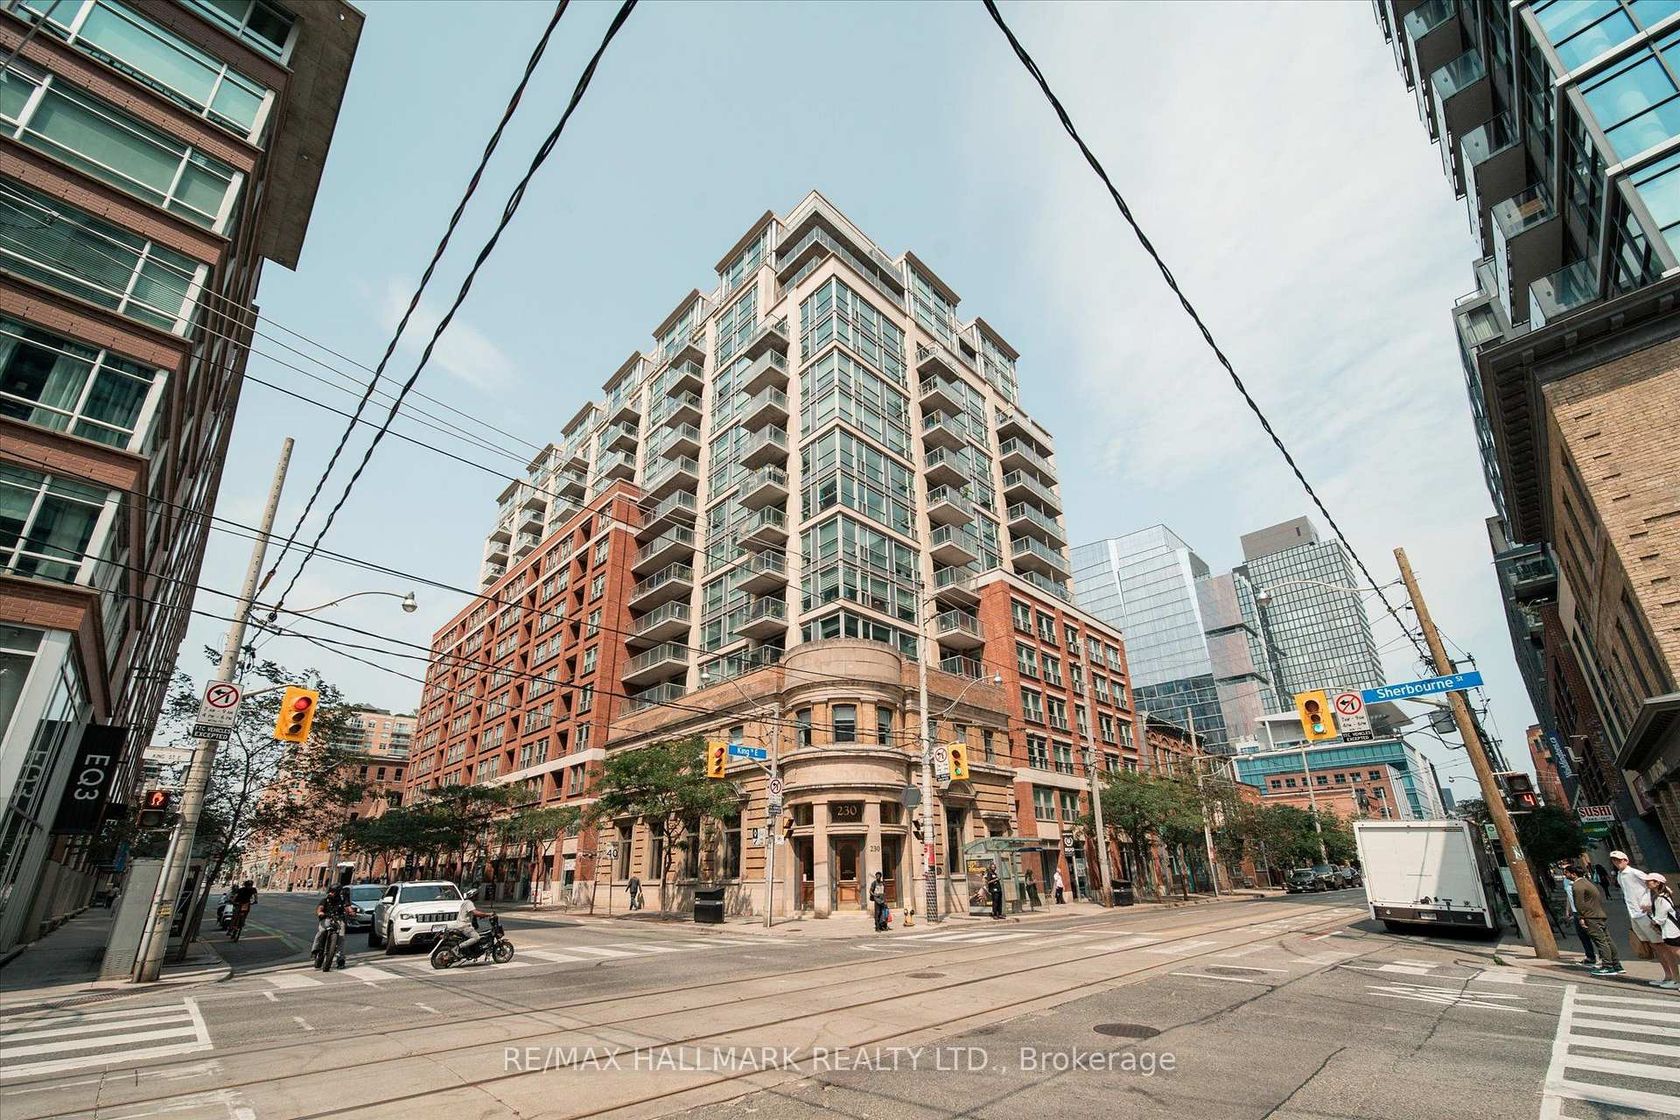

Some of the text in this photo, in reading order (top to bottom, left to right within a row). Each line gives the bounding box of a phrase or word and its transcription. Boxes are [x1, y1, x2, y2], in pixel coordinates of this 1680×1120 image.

[1376, 679, 1454, 699] Sherbourne
[208, 726, 231, 734] VEHICLES
[194, 732, 229, 740] EXCEPTED
[736, 747, 750, 758] King
[73, 754, 110, 800] EQ3
[1523, 794, 1535, 806] 4
[837, 805, 857, 816] 230
[1579, 806, 1612, 818] SUSHI
[607, 849, 619, 858] 40
